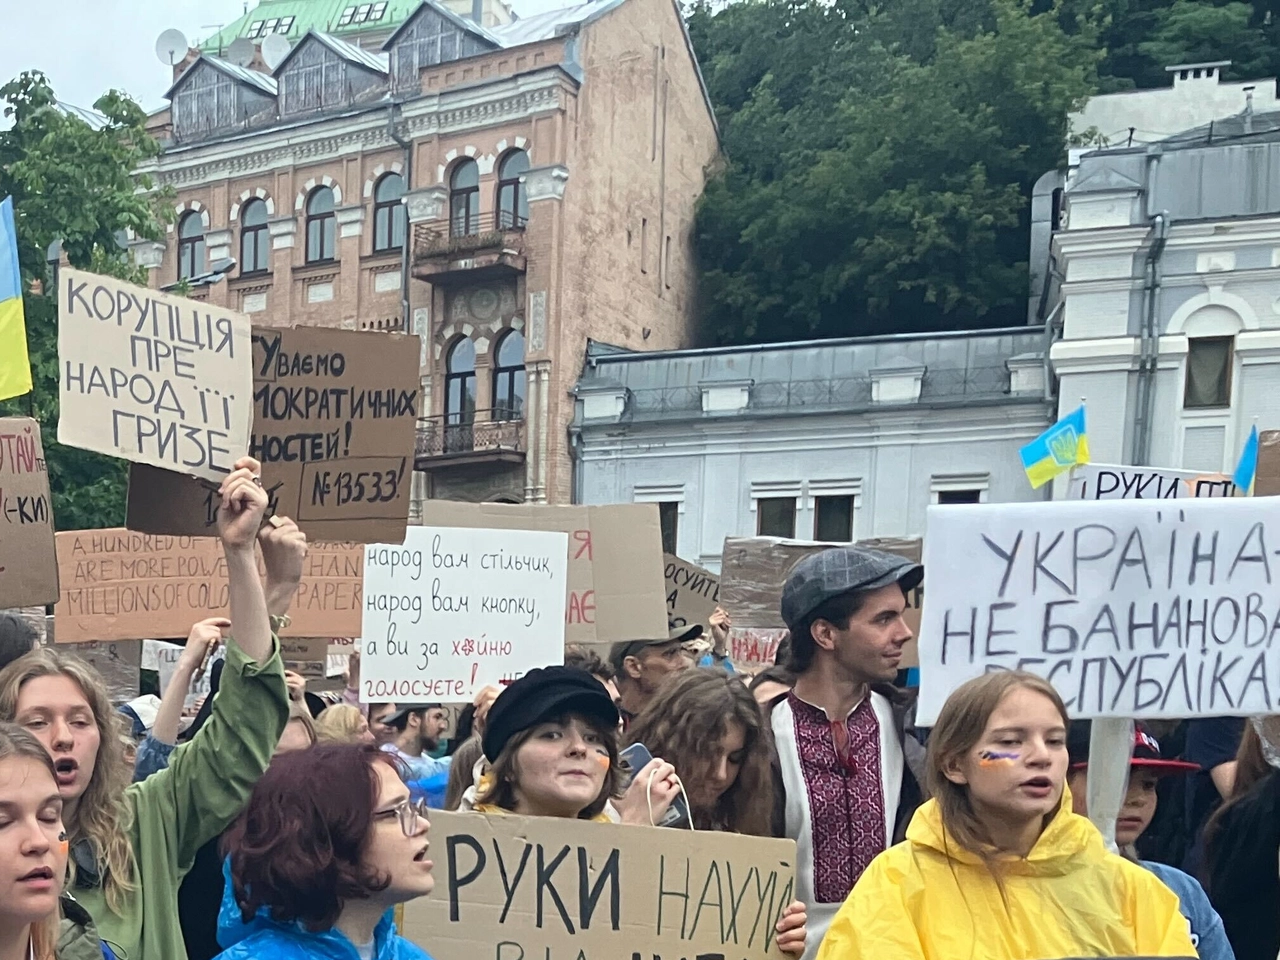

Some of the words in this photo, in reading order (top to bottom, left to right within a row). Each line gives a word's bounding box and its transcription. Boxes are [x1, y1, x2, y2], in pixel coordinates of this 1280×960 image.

[67, 278, 235, 358] КОРУПЦІЯ
[130, 334, 196, 380] ПРЕ
[65, 360, 185, 420] НАРОД
[111, 409, 232, 473] ГРИЗЕ
[72, 537, 87, 557] A
[92, 535, 174, 554] HUNDRED
[74, 559, 114, 583] ARE
[120, 556, 172, 579] MORE
[366, 547, 423, 581] народ
[431, 534, 469, 570] вам
[480, 549, 555, 580] стільчик,
[66, 583, 161, 616] MILLIONS
[163, 582, 185, 610] OF
[366, 592, 423, 625] народ
[431, 577, 469, 612] вам
[480, 596, 541, 628] кнопку,
[366, 641, 378, 657] а
[386, 622, 409, 657] ви
[420, 642, 439, 671] за
[941, 602, 1018, 665] НЕ
[364, 663, 478, 698] голосуєте!
[446, 833, 620, 935] РУКИ
[656, 854, 794, 953] НАХУЙ
